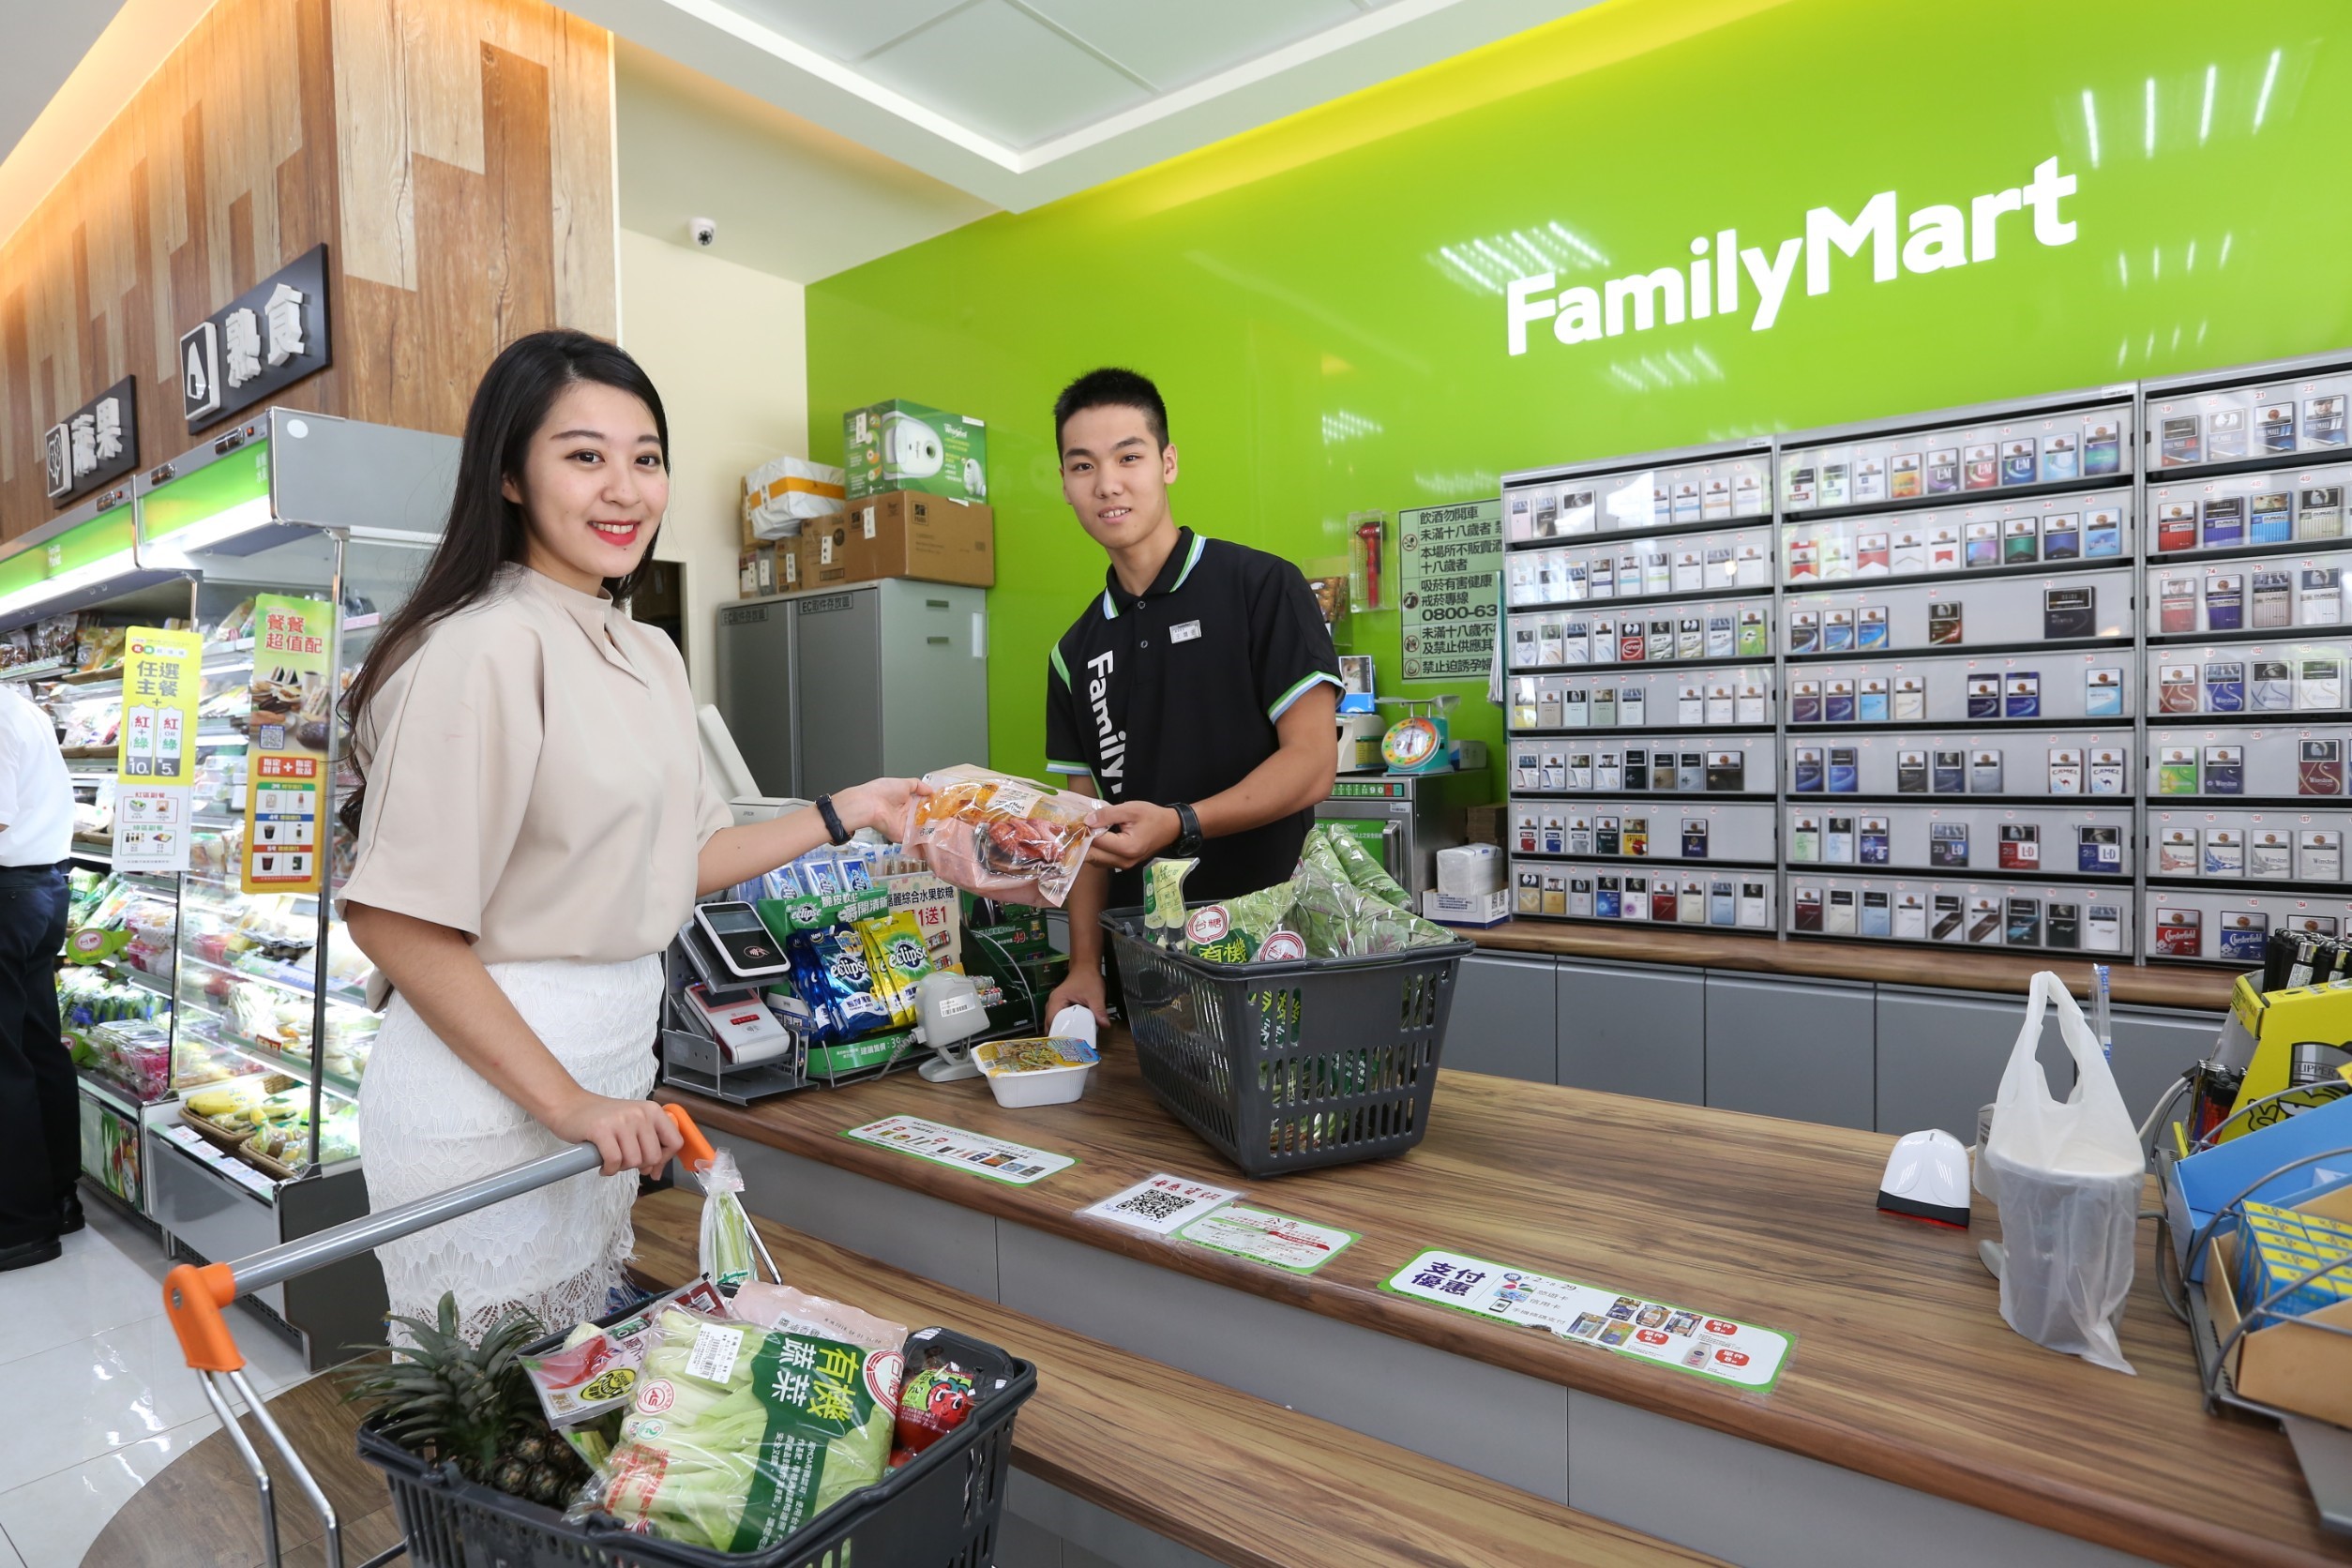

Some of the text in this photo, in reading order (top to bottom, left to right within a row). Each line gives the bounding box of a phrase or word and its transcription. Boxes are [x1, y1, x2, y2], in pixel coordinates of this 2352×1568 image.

[1506, 155, 2077, 356] FamilyMart
[1420, 506, 1478, 524] 飲酒勿開車
[1420, 522, 1491, 541] 未滿十八歲者
[1422, 559, 1468, 575] 十八歲者
[1422, 574, 1493, 592] 吸菸有害健康
[1422, 590, 1469, 607] 戒菸專線
[1422, 604, 1497, 621] 0800-63
[267, 613, 304, 633] 餐餐
[265, 632, 323, 654] 超值配
[137, 660, 179, 679] 任選
[136, 679, 178, 697] 主餐
[135, 716, 150, 728] 紅
[164, 717, 178, 730] 紅
[791, 904, 822, 920] eclipse
[1195, 918, 1222, 932] 台糖
[2164, 928, 2196, 941] Chesterfield
[2229, 933, 2263, 945] Chesterfield
[1199, 938, 1247, 963] 有機
[1423, 1261, 1486, 1284] 支付
[1410, 1273, 1475, 1297] 優惠
[1529, 1298, 1561, 1309] 信用卡
[1537, 1289, 1569, 1301] 悠遊卡
[771, 1337, 817, 1407] 蔬菜
[807, 1348, 859, 1421] 有機
